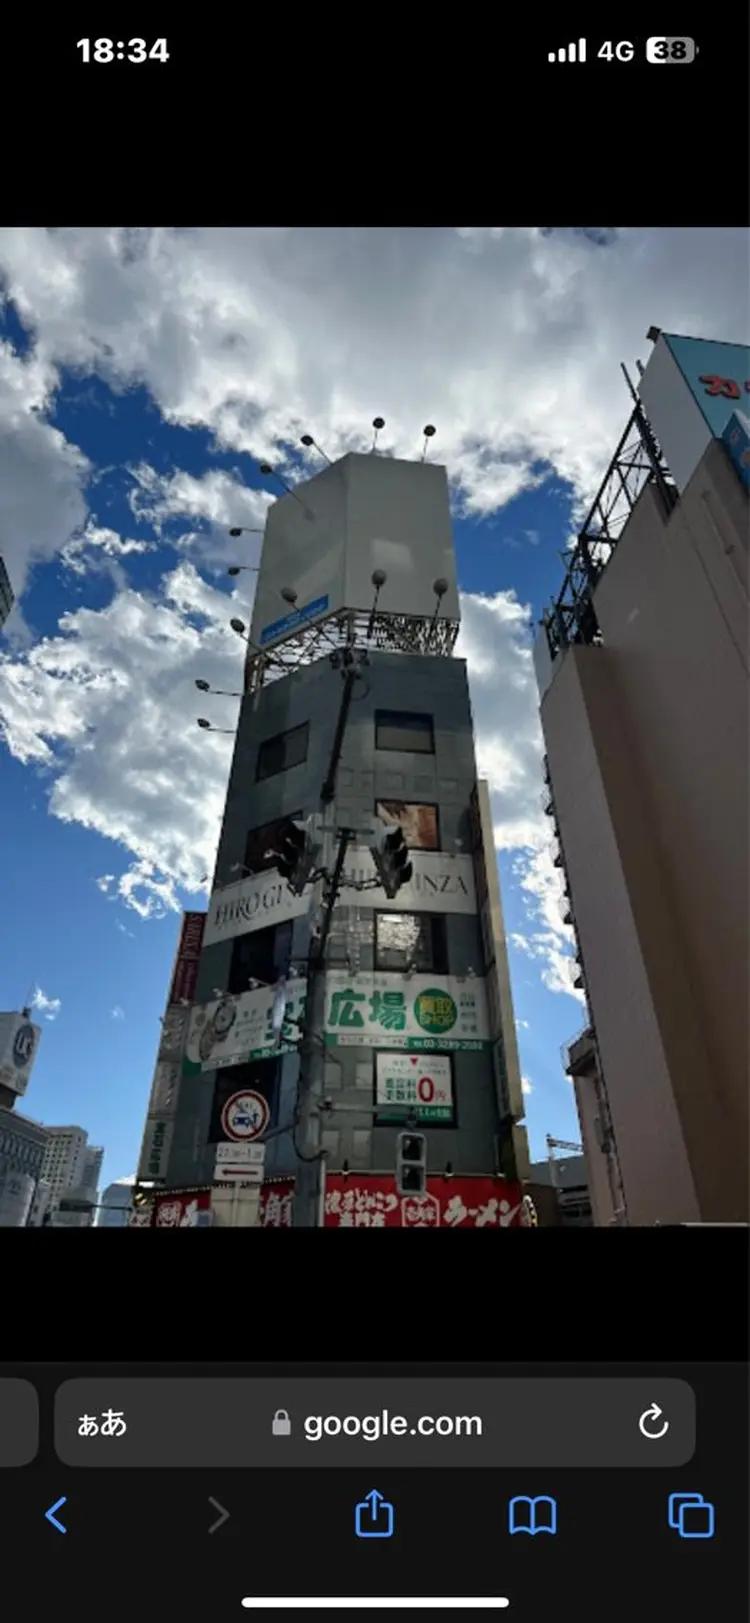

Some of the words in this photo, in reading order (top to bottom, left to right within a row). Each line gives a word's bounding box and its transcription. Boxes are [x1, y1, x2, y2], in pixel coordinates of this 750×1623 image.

[328, 988, 407, 1030] 広場
[443, 1194, 521, 1227] ラーメン
